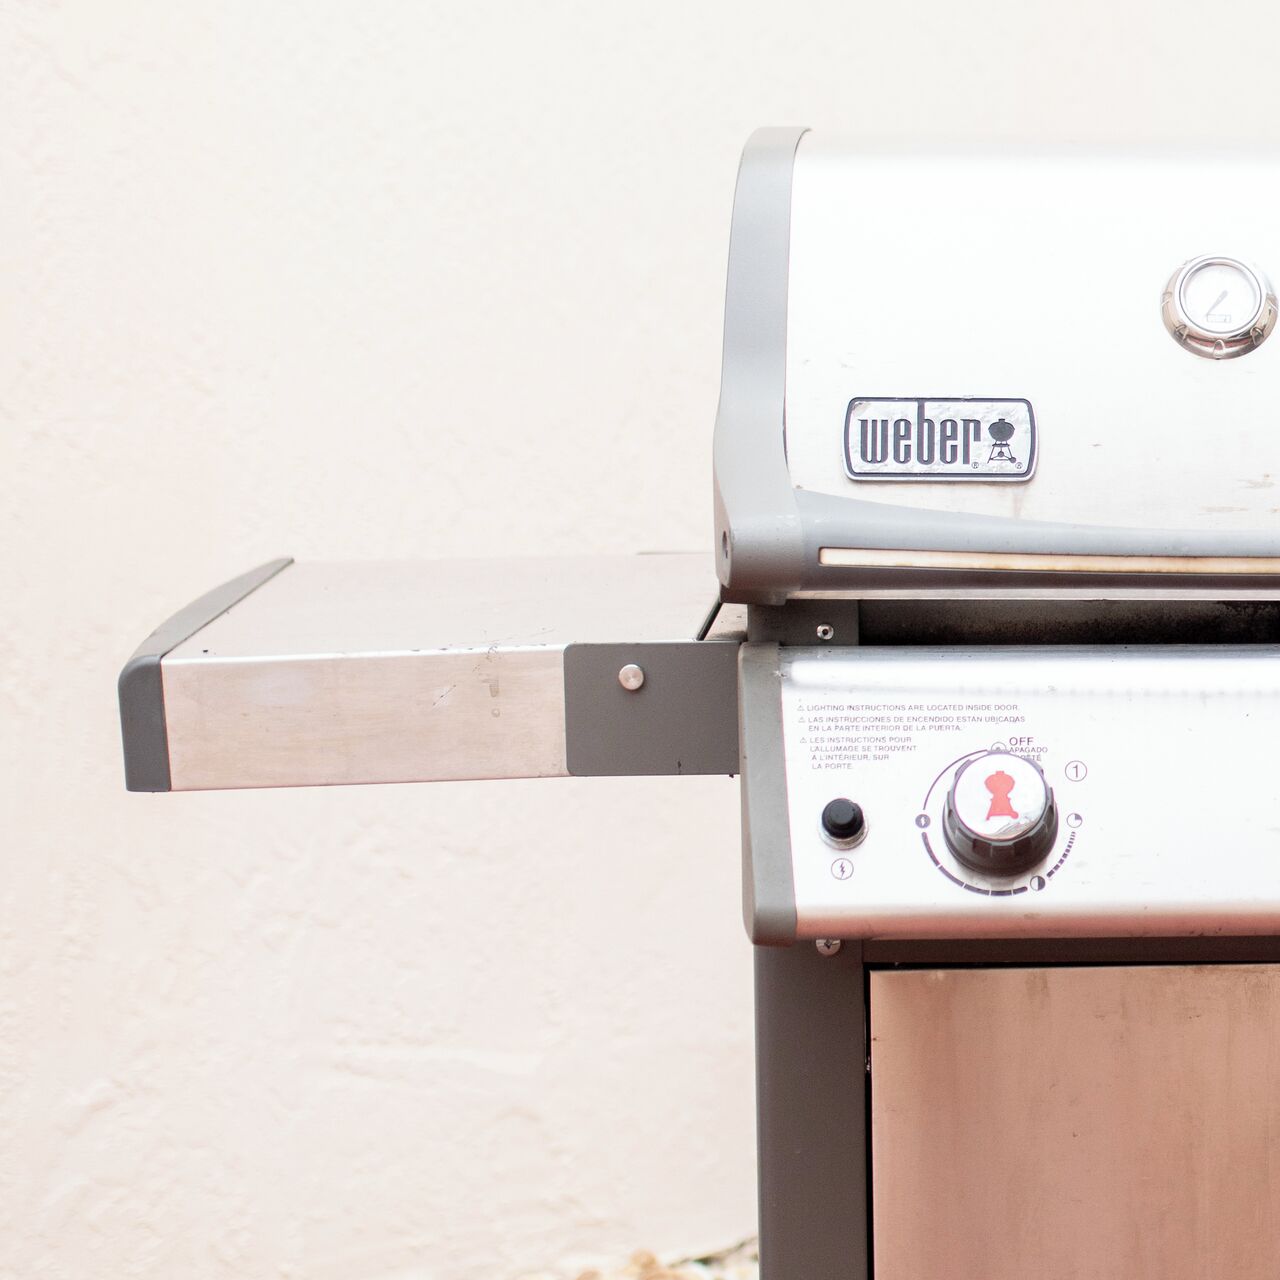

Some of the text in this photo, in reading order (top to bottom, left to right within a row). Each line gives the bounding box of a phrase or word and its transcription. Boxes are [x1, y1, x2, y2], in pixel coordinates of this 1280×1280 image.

[806, 704, 845, 712] LIGHTING
[847, 704, 906, 712] INSTRUCTIONS
[908, 704, 924, 712] ARE
[926, 704, 964, 712] LOCATED
[965, 704, 992, 712] INSIDE
[1009, 736, 1034, 746] OFF
